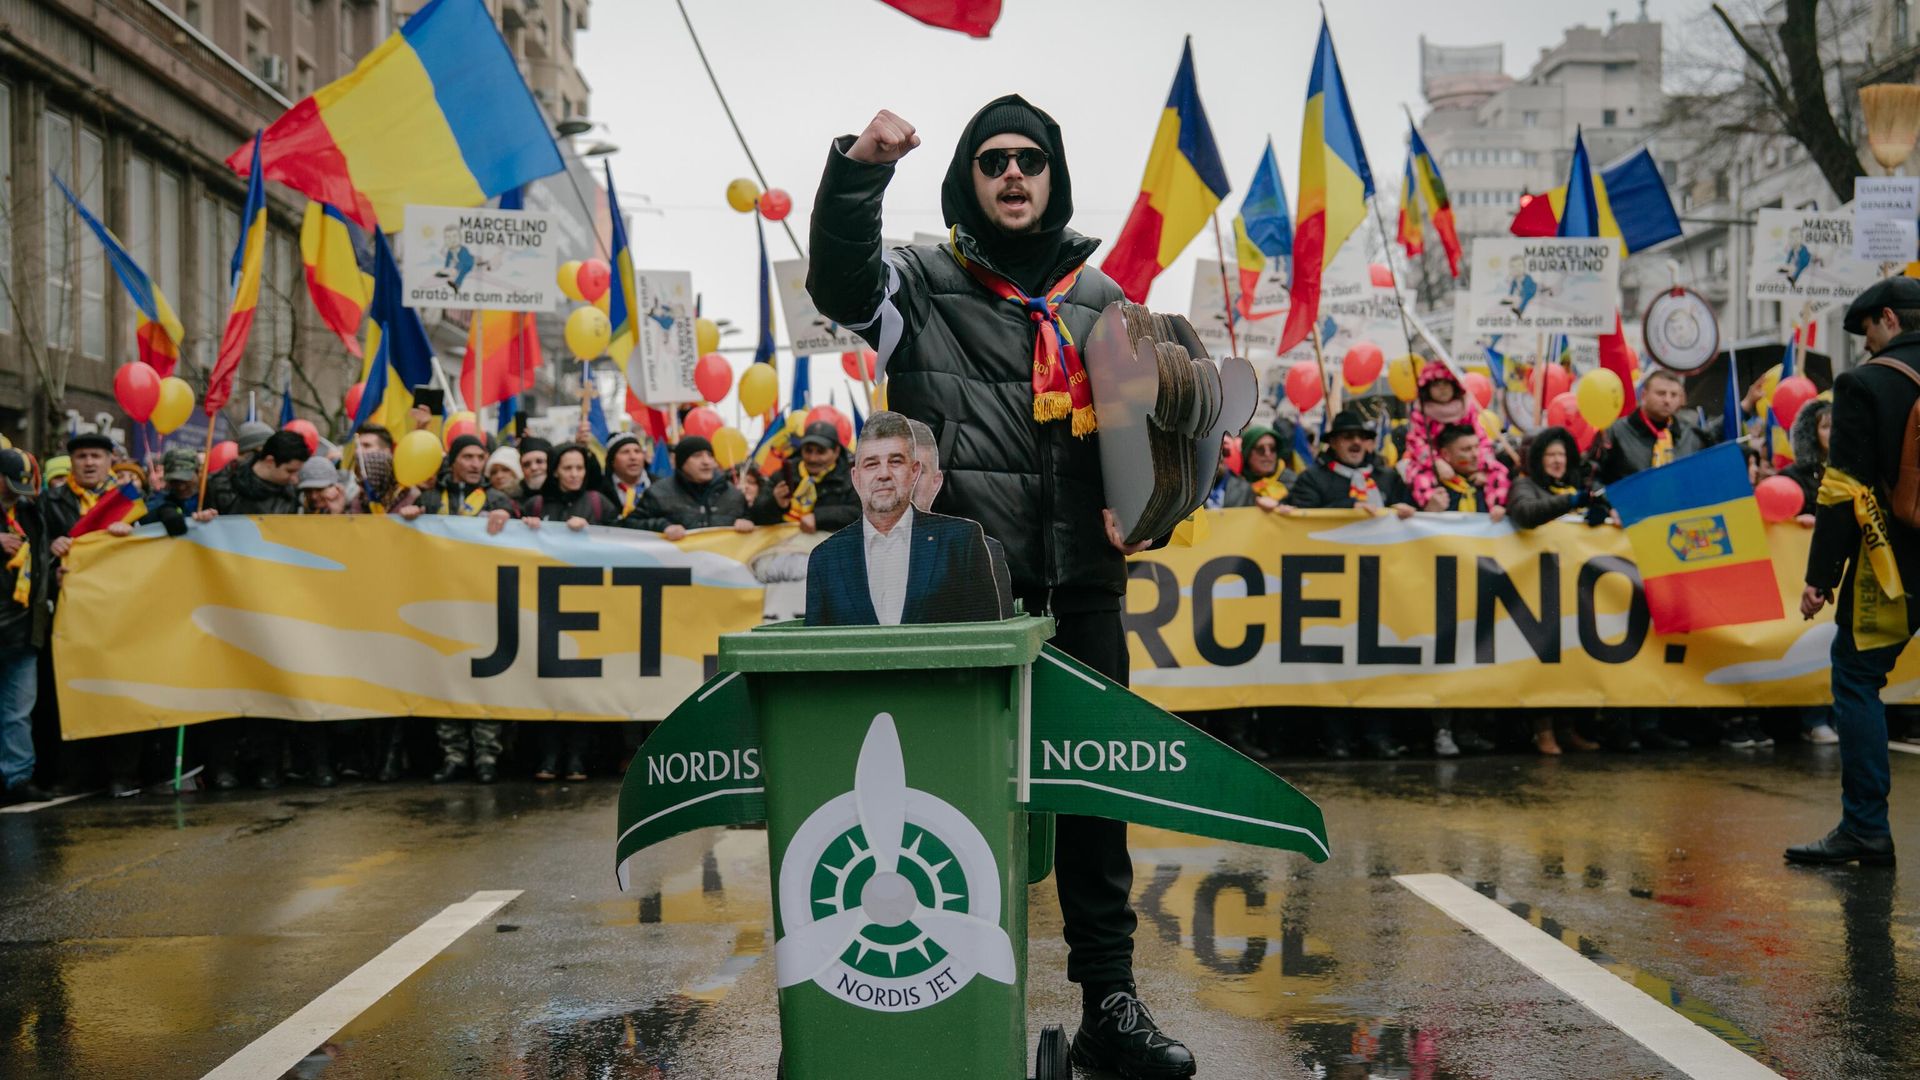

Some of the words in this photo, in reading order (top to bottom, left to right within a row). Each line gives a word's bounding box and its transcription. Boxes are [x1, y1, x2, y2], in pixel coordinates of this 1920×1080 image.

[460, 217, 547, 233] MARCELINO
[1802, 218, 1852, 232] MARCEL
[464, 232, 542, 247] BURATINO
[1805, 230, 1853, 246] BURATI
[1524, 246, 1609, 259] MARCELINO
[1528, 259, 1604, 272] BURATINO
[1806, 285, 1830, 296] cum
[474, 292, 502, 302] cum
[506, 292, 543, 305] zbori!
[1536, 317, 1563, 327] cum
[1567, 314, 1603, 328] zbori!
[1119, 553, 1688, 669] RCELINO
[1041, 740, 1187, 772] NORDIS
[648, 748, 760, 786] NORDIS
[837, 973, 921, 1007] NORDIS
[926, 966, 958, 1001] JET
